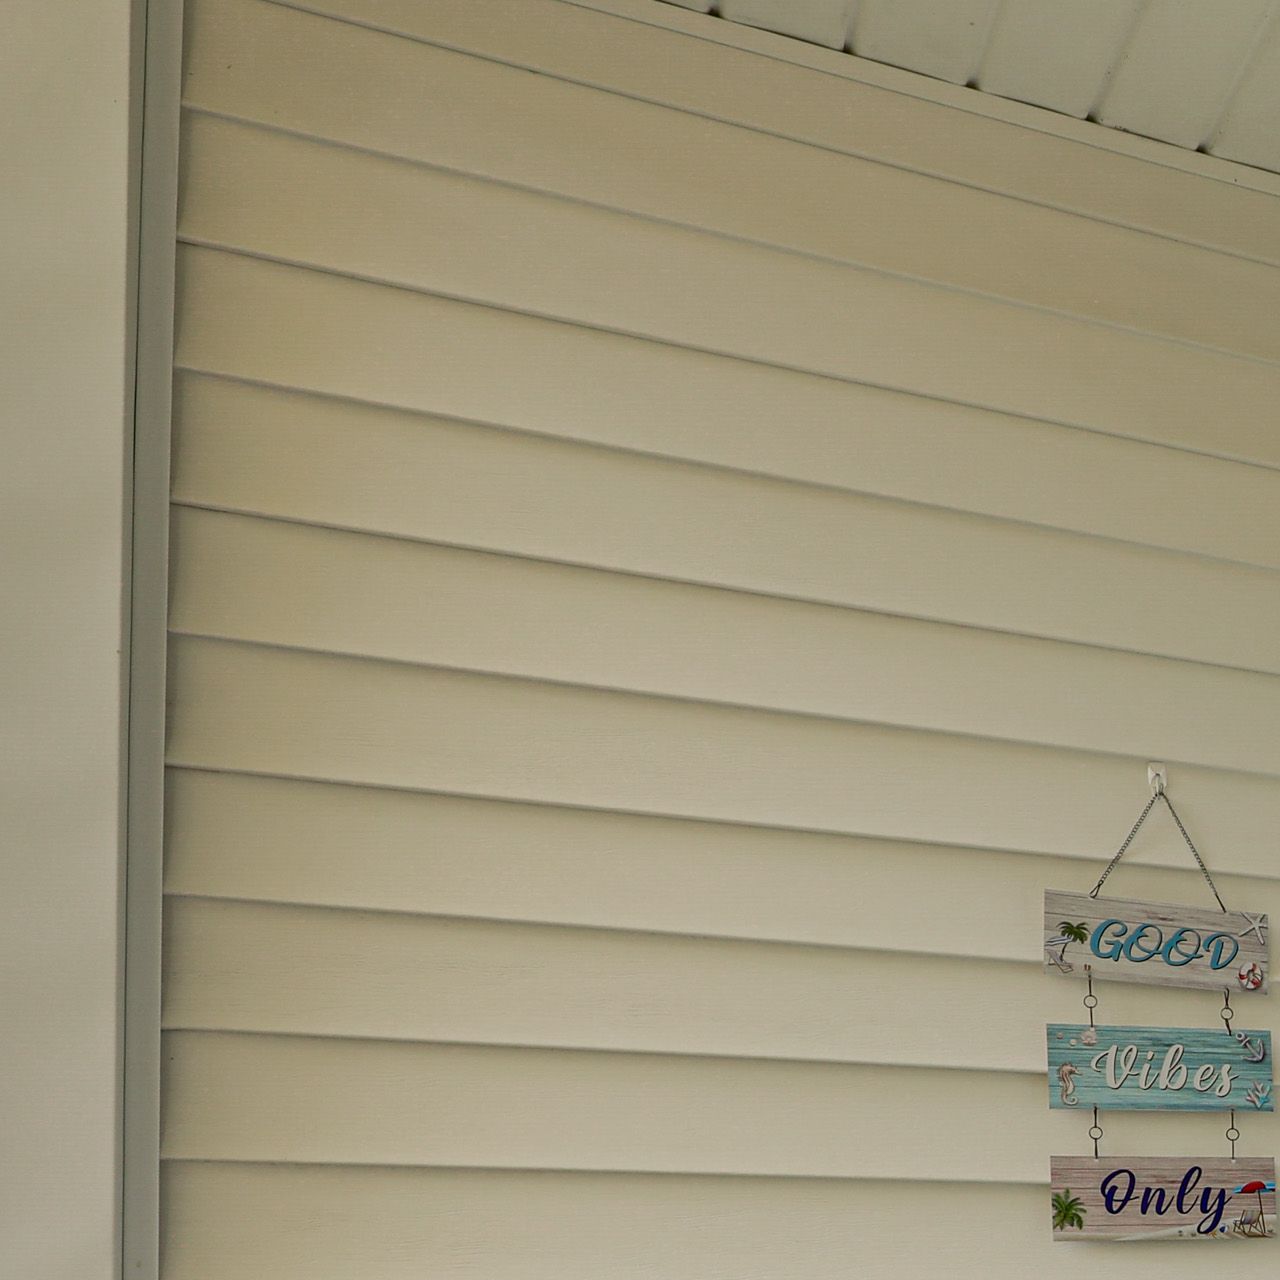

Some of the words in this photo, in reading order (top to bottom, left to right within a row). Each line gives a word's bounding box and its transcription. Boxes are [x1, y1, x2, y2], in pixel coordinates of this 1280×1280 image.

[1089, 918, 1239, 970] GOOD
[1091, 1044, 1239, 1097] Vibes
[1100, 1166, 1232, 1234] Only
